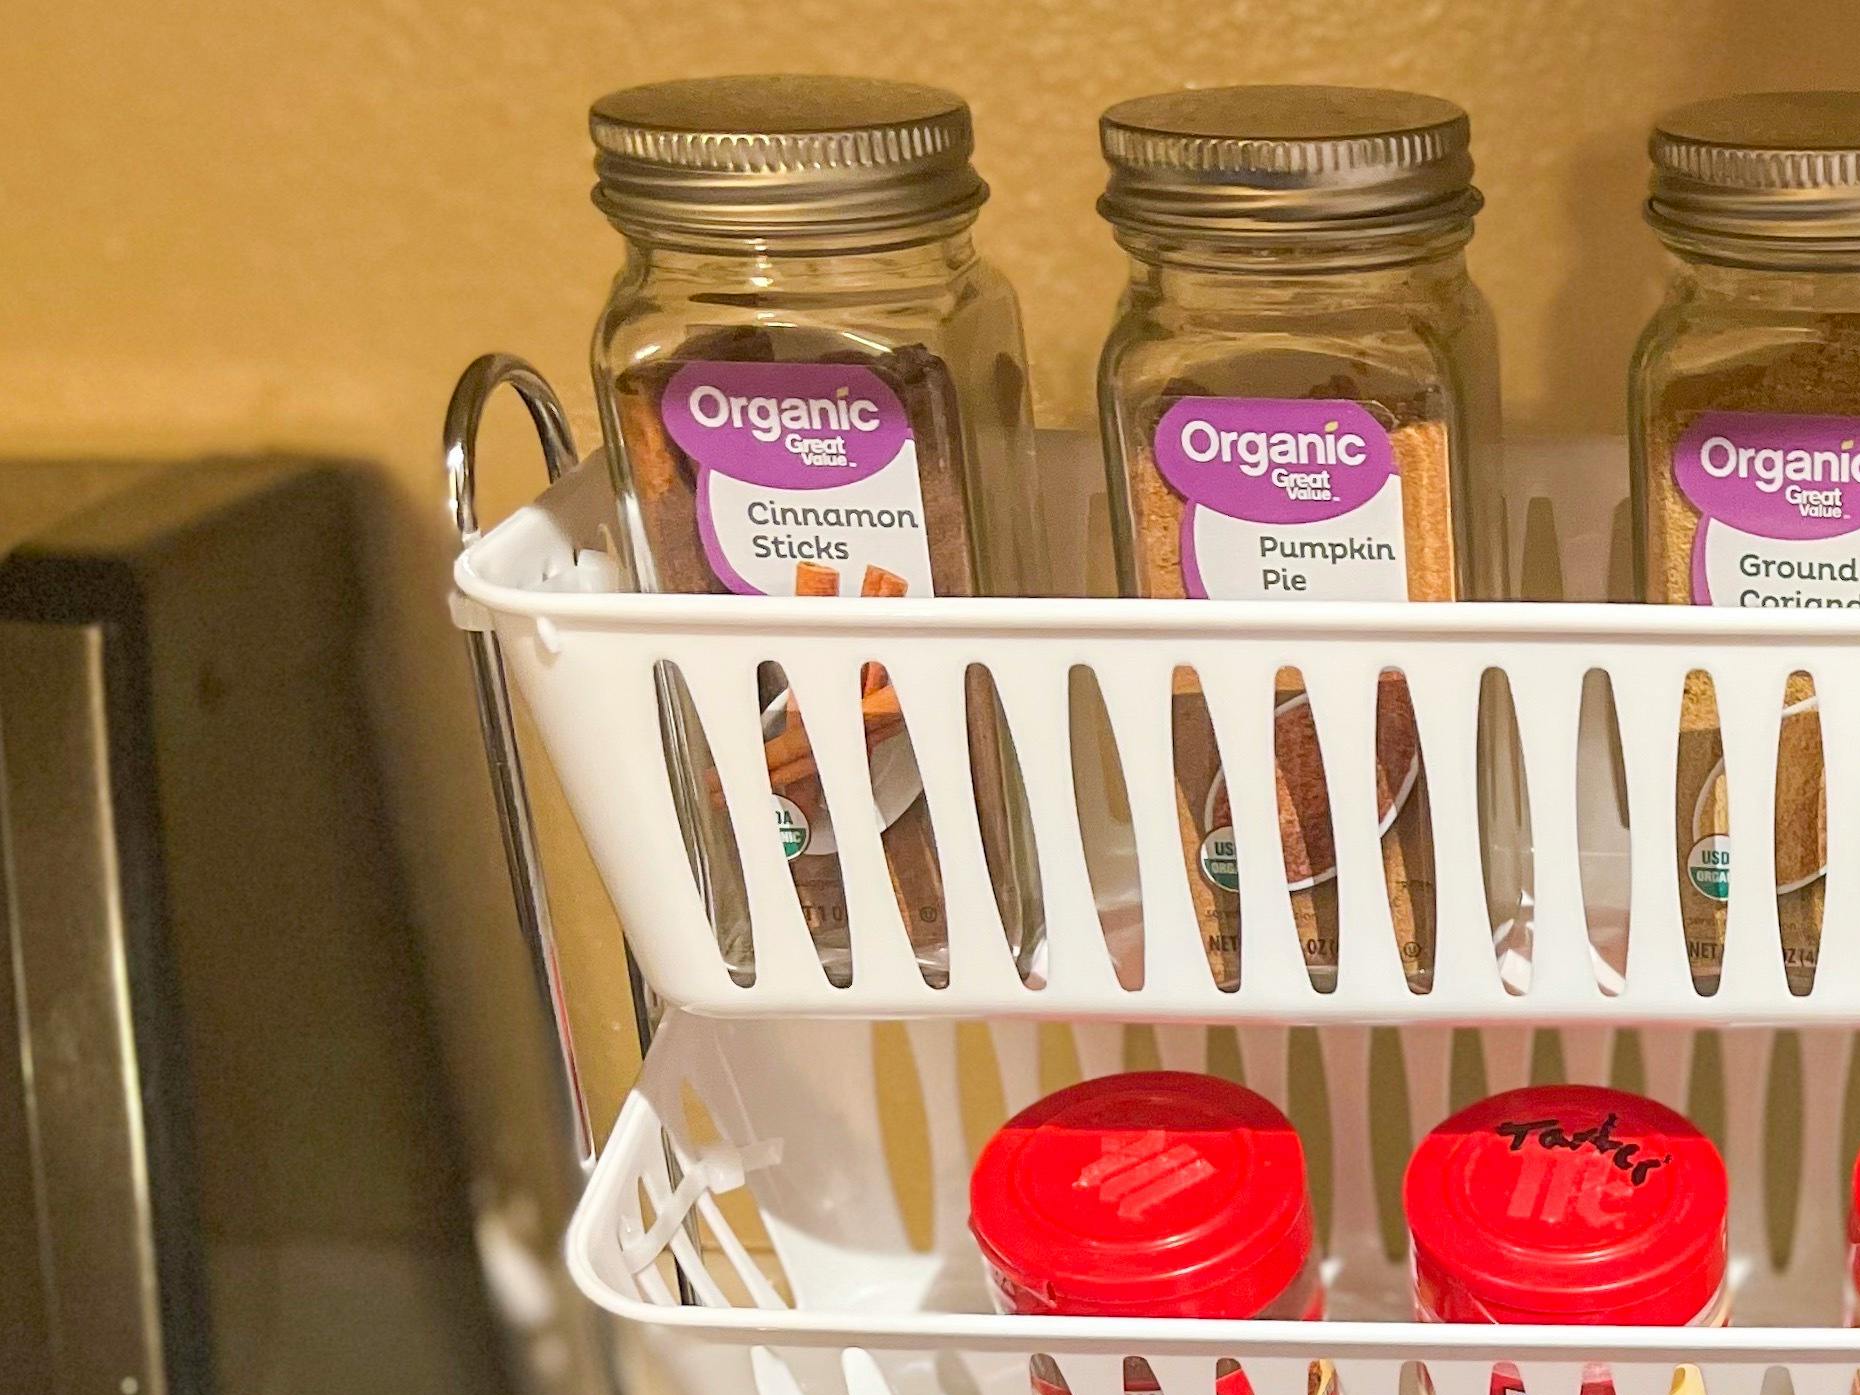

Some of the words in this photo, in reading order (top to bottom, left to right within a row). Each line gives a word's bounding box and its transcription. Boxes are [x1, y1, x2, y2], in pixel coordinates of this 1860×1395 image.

[689, 386, 880, 442] Organic
[785, 433, 846, 455] Great
[1181, 420, 1367, 477] Organic
[801, 452, 848, 468] Value
[1271, 468, 1331, 489] Great
[1286, 486, 1332, 501] Value
[1786, 484, 1842, 507] Great
[747, 501, 919, 529] Cinnamon
[1800, 504, 1842, 519] Value
[752, 535, 849, 560] Sticks
[1260, 536, 1396, 565] Pumpkin
[1262, 568, 1307, 591] Pie
[1739, 554, 1859, 582] Ground
[1702, 850, 1730, 866] USD
